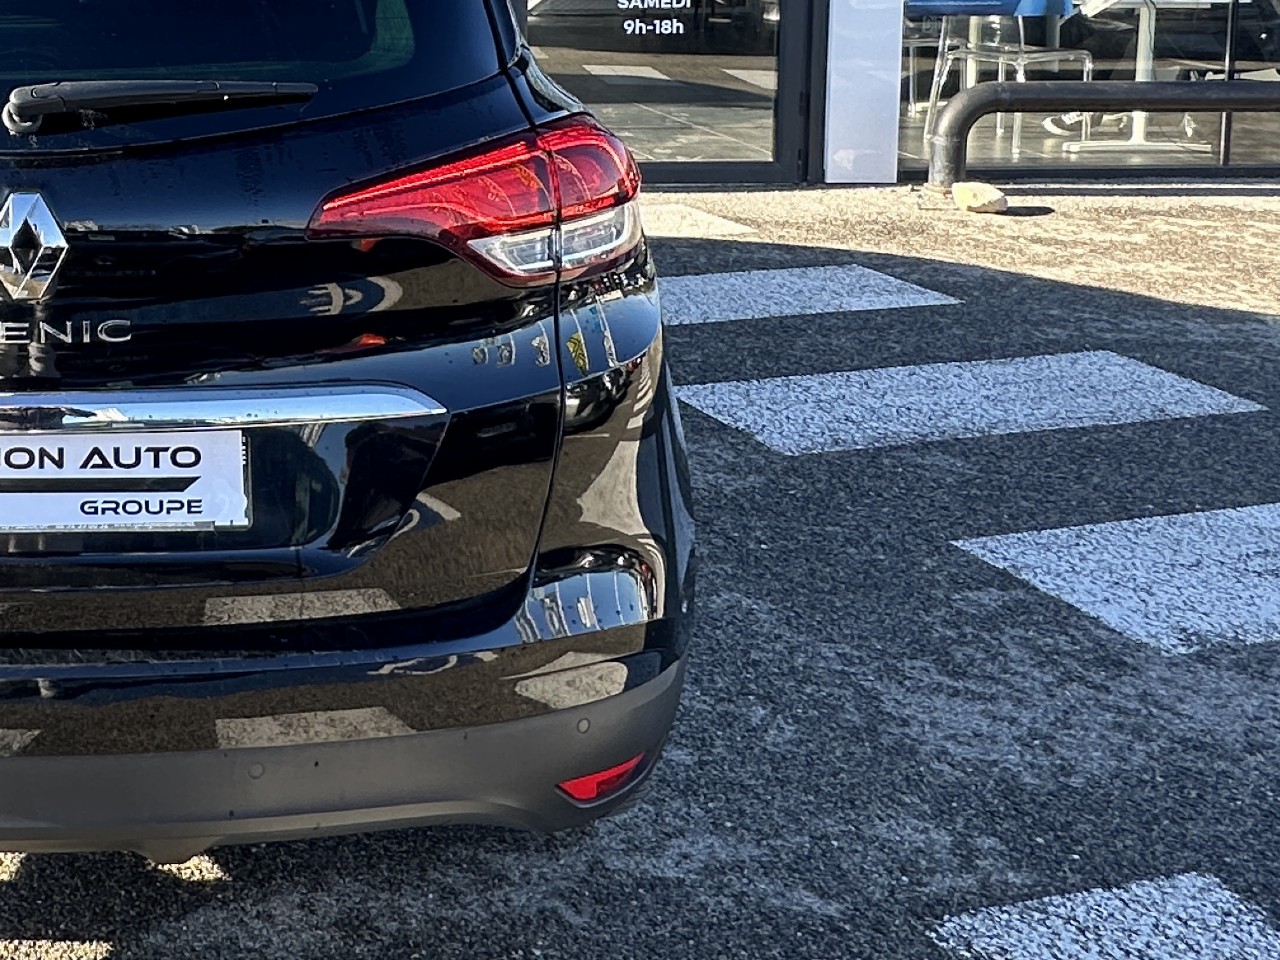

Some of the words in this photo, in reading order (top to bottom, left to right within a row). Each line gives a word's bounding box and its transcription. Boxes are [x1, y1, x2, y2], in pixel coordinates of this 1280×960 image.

[623, 18, 685, 35] 9h-18h
[79, 446, 203, 470] AUTO
[80, 498, 204, 516] GROUPE
